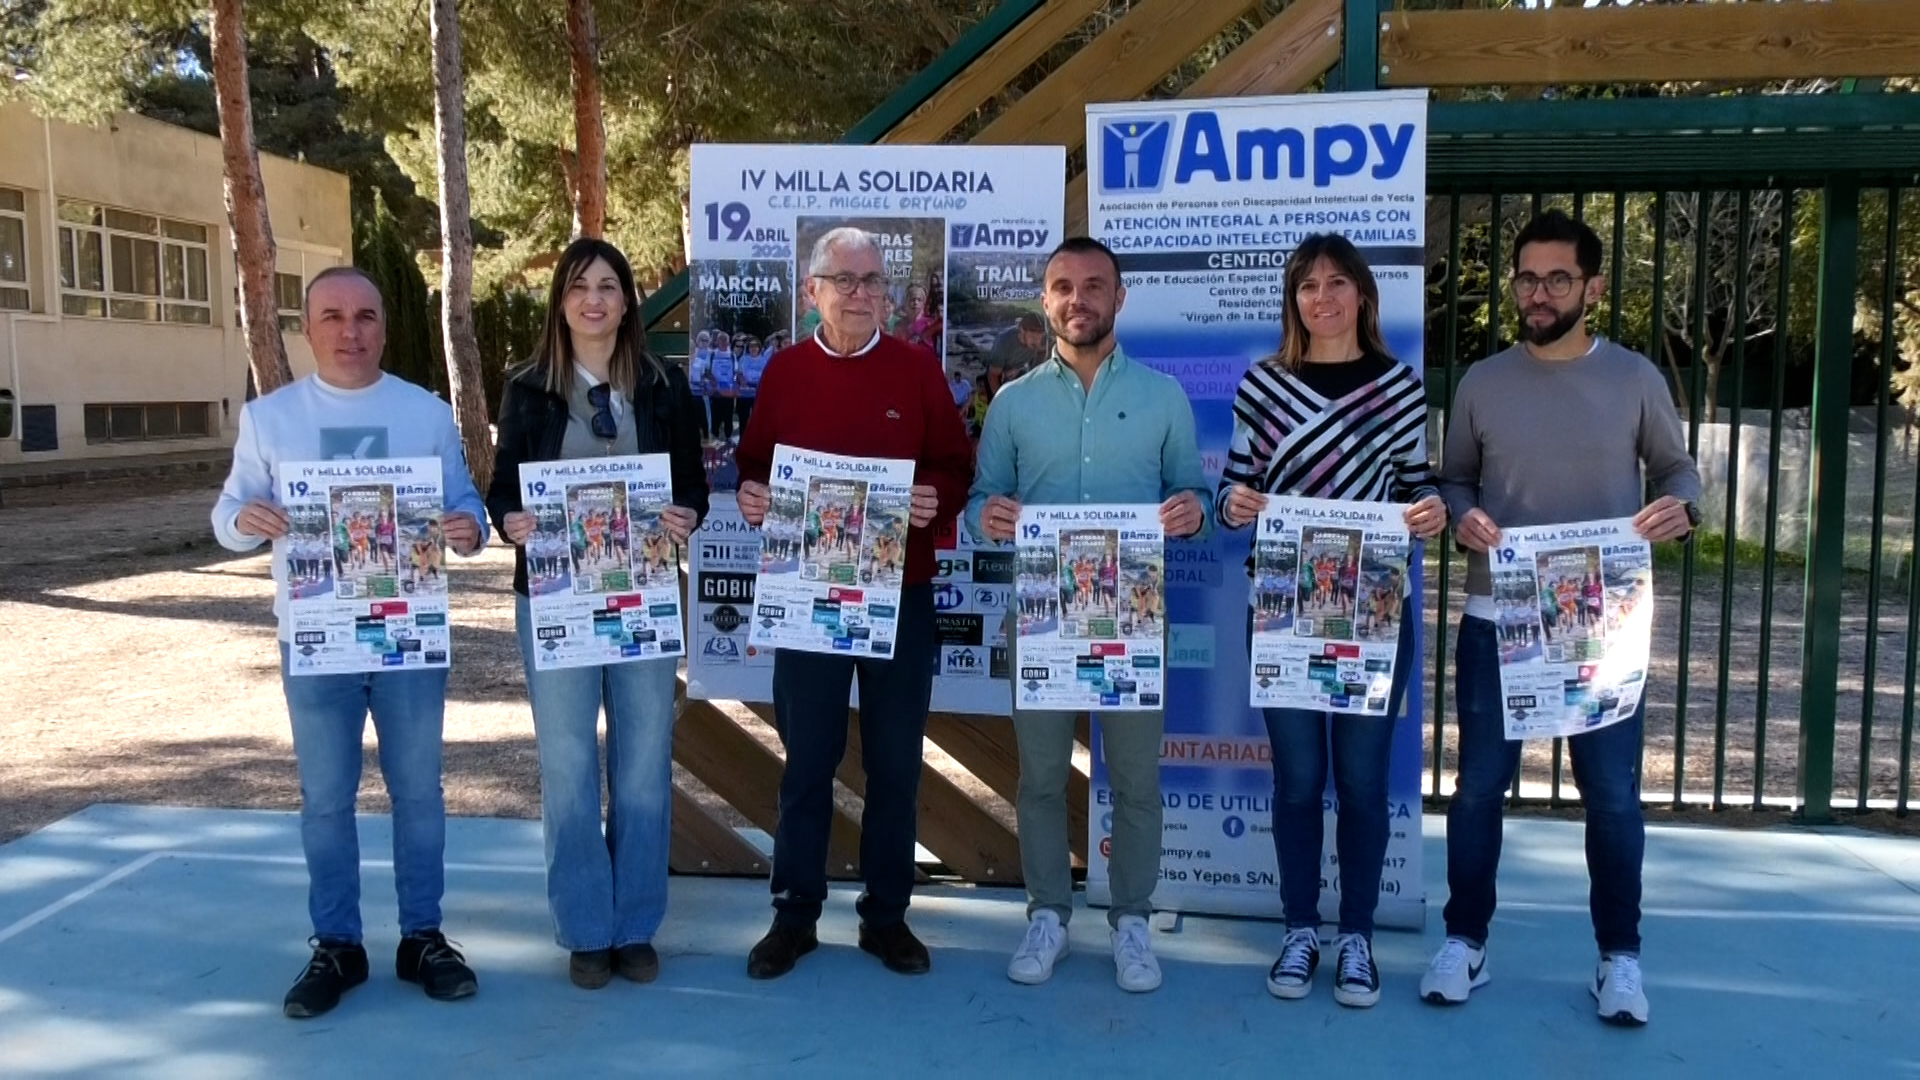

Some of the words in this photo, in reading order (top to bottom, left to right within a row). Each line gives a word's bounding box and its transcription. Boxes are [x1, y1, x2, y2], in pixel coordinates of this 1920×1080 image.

[1175, 111, 1415, 187] Ampy
[742, 169, 766, 191] IV
[775, 170, 850, 192] MILLA
[859, 170, 994, 193] SOLIDARIA
[768, 195, 822, 209] C.E.I.P.
[829, 196, 890, 210] MIGUEL
[899, 196, 968, 211] ORTUÑO
[1099, 201, 1153, 211] Asociación
[1156, 201, 1168, 210] de
[1172, 200, 1218, 210] Personas
[1221, 200, 1240, 208] con
[1243, 196, 1312, 206] Discapacidad
[1315, 195, 1368, 204] Intelectual
[1371, 194, 1384, 202] de
[1387, 193, 1415, 202] Yecla
[704, 201, 751, 242] 19
[1104, 214, 1181, 231] ATENCIÓN
[1186, 213, 1263, 228] INTEGRAL
[1269, 214, 1280, 226] A
[1285, 210, 1371, 225] PERSONAS
[1376, 209, 1410, 222] CON
[743, 228, 791, 242] ABRIL
[974, 223, 1049, 249] Ampy
[1098, 233, 1212, 249] DISCAPACIDAD
[1344, 229, 1416, 244] FAMILIAS
[751, 244, 792, 258] 2026
[975, 265, 1034, 282] TRAIL
[1147, 276, 1160, 285] de
[1164, 273, 1224, 285] Educación
[1229, 271, 1277, 284] Especial
[699, 275, 782, 292] MARCHA
[1209, 286, 1248, 296] Centro
[1252, 286, 1266, 295] de
[718, 293, 762, 308] MILLA
[1218, 298, 1282, 309] Residencia
[1227, 312, 1240, 321] de
[1244, 311, 1254, 320] la
[303, 467, 313, 477] IV
[318, 467, 352, 476] MILLA
[355, 465, 413, 476] SOLIDARIA
[541, 468, 551, 477] IV
[555, 467, 586, 476] MILLA
[589, 463, 644, 474] SOLIDARIA
[791, 453, 801, 462] IV
[804, 456, 832, 469] MILLA
[835, 461, 888, 474] SOLIDARIA
[777, 465, 793, 480] 19
[288, 481, 309, 497] 19
[527, 481, 547, 497] 19
[1036, 511, 1046, 519] IV
[1050, 511, 1081, 520] MILLA
[1083, 511, 1137, 520] SOLIDARIA
[1295, 508, 1326, 518] MILLA
[1329, 510, 1384, 522] SOLIDARIA
[1022, 523, 1041, 539] 19
[1265, 518, 1284, 533] 19
[1509, 533, 1520, 543] IV
[1524, 532, 1557, 542] MILLA
[1560, 527, 1619, 539] SOLIDARIA
[1496, 547, 1515, 564] 19
[1188, 793, 1215, 810] DE
[1193, 870, 1241, 885] Yepes
